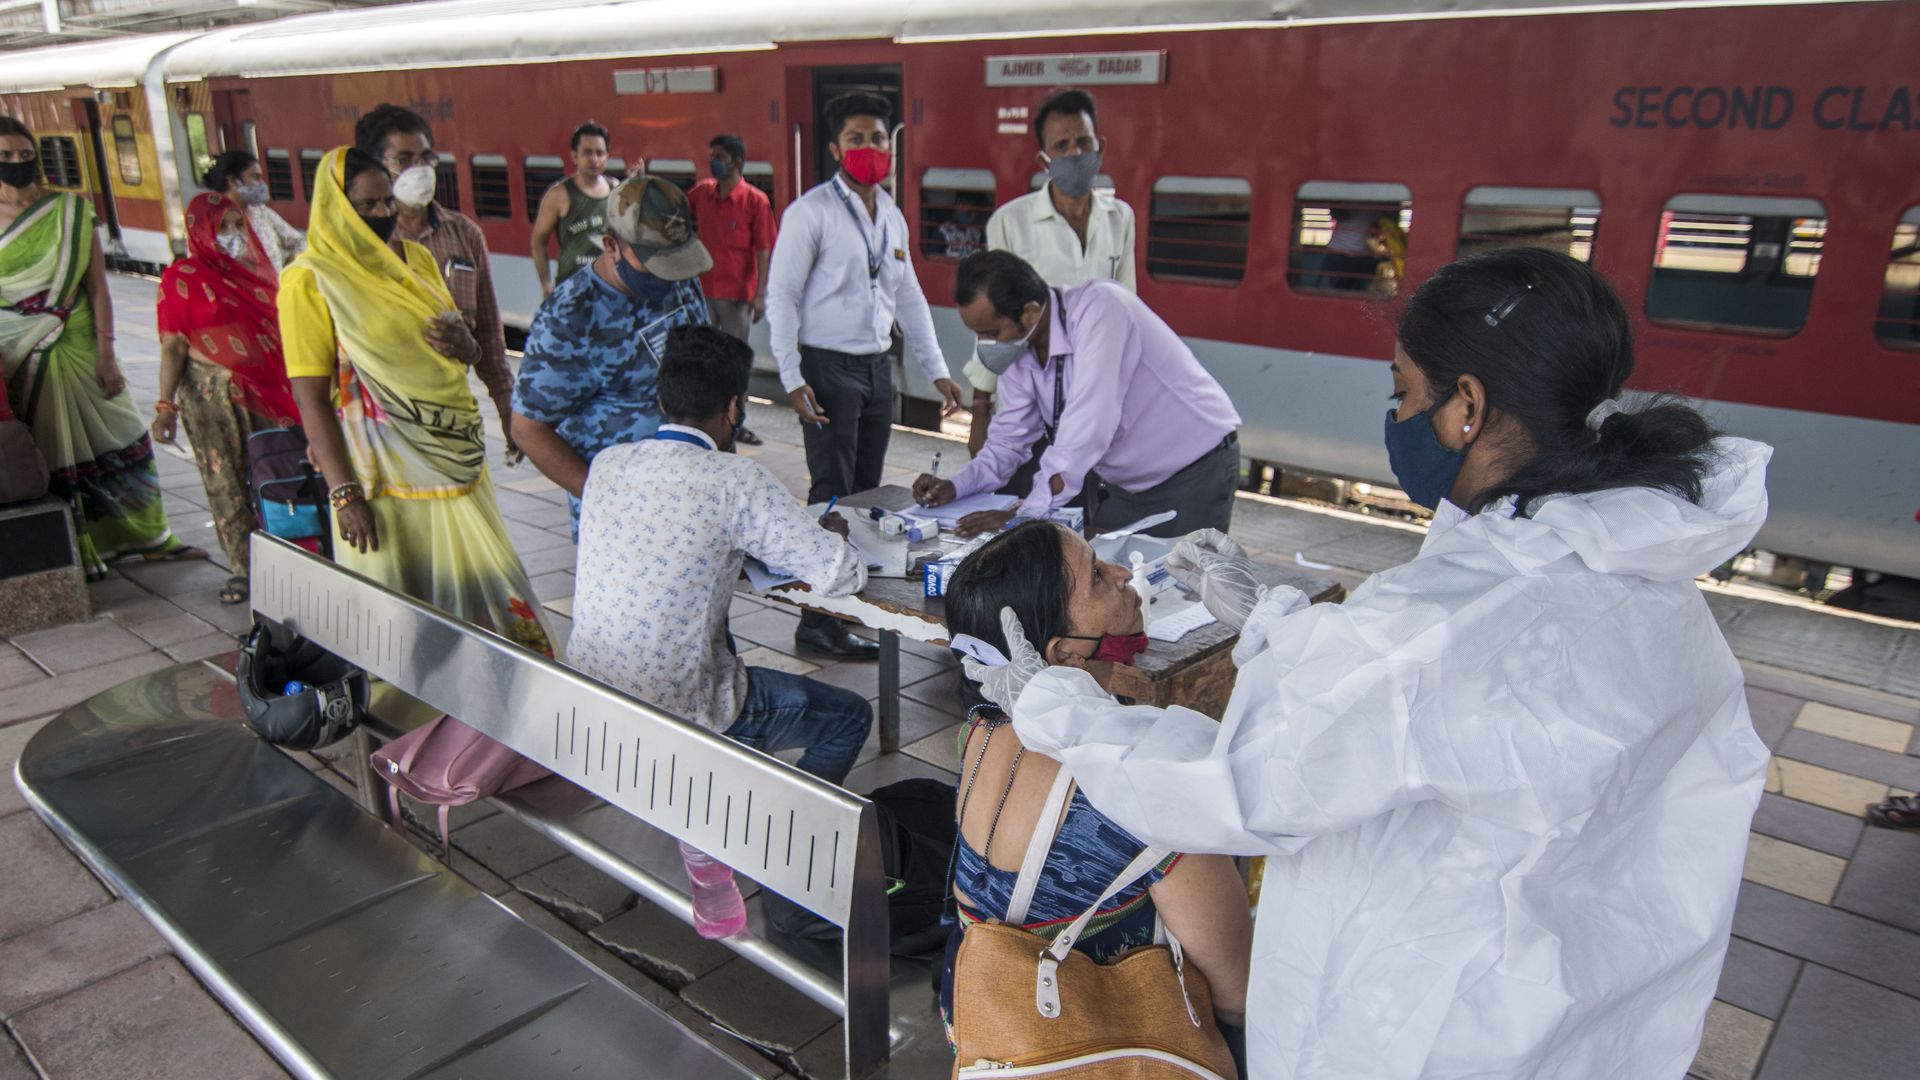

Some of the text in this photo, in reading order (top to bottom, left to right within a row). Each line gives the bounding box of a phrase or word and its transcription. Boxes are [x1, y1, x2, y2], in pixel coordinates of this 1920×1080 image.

[1002, 58, 1142, 77] AJMER DADAR
[1609, 85, 1920, 131] SECOND CLA
